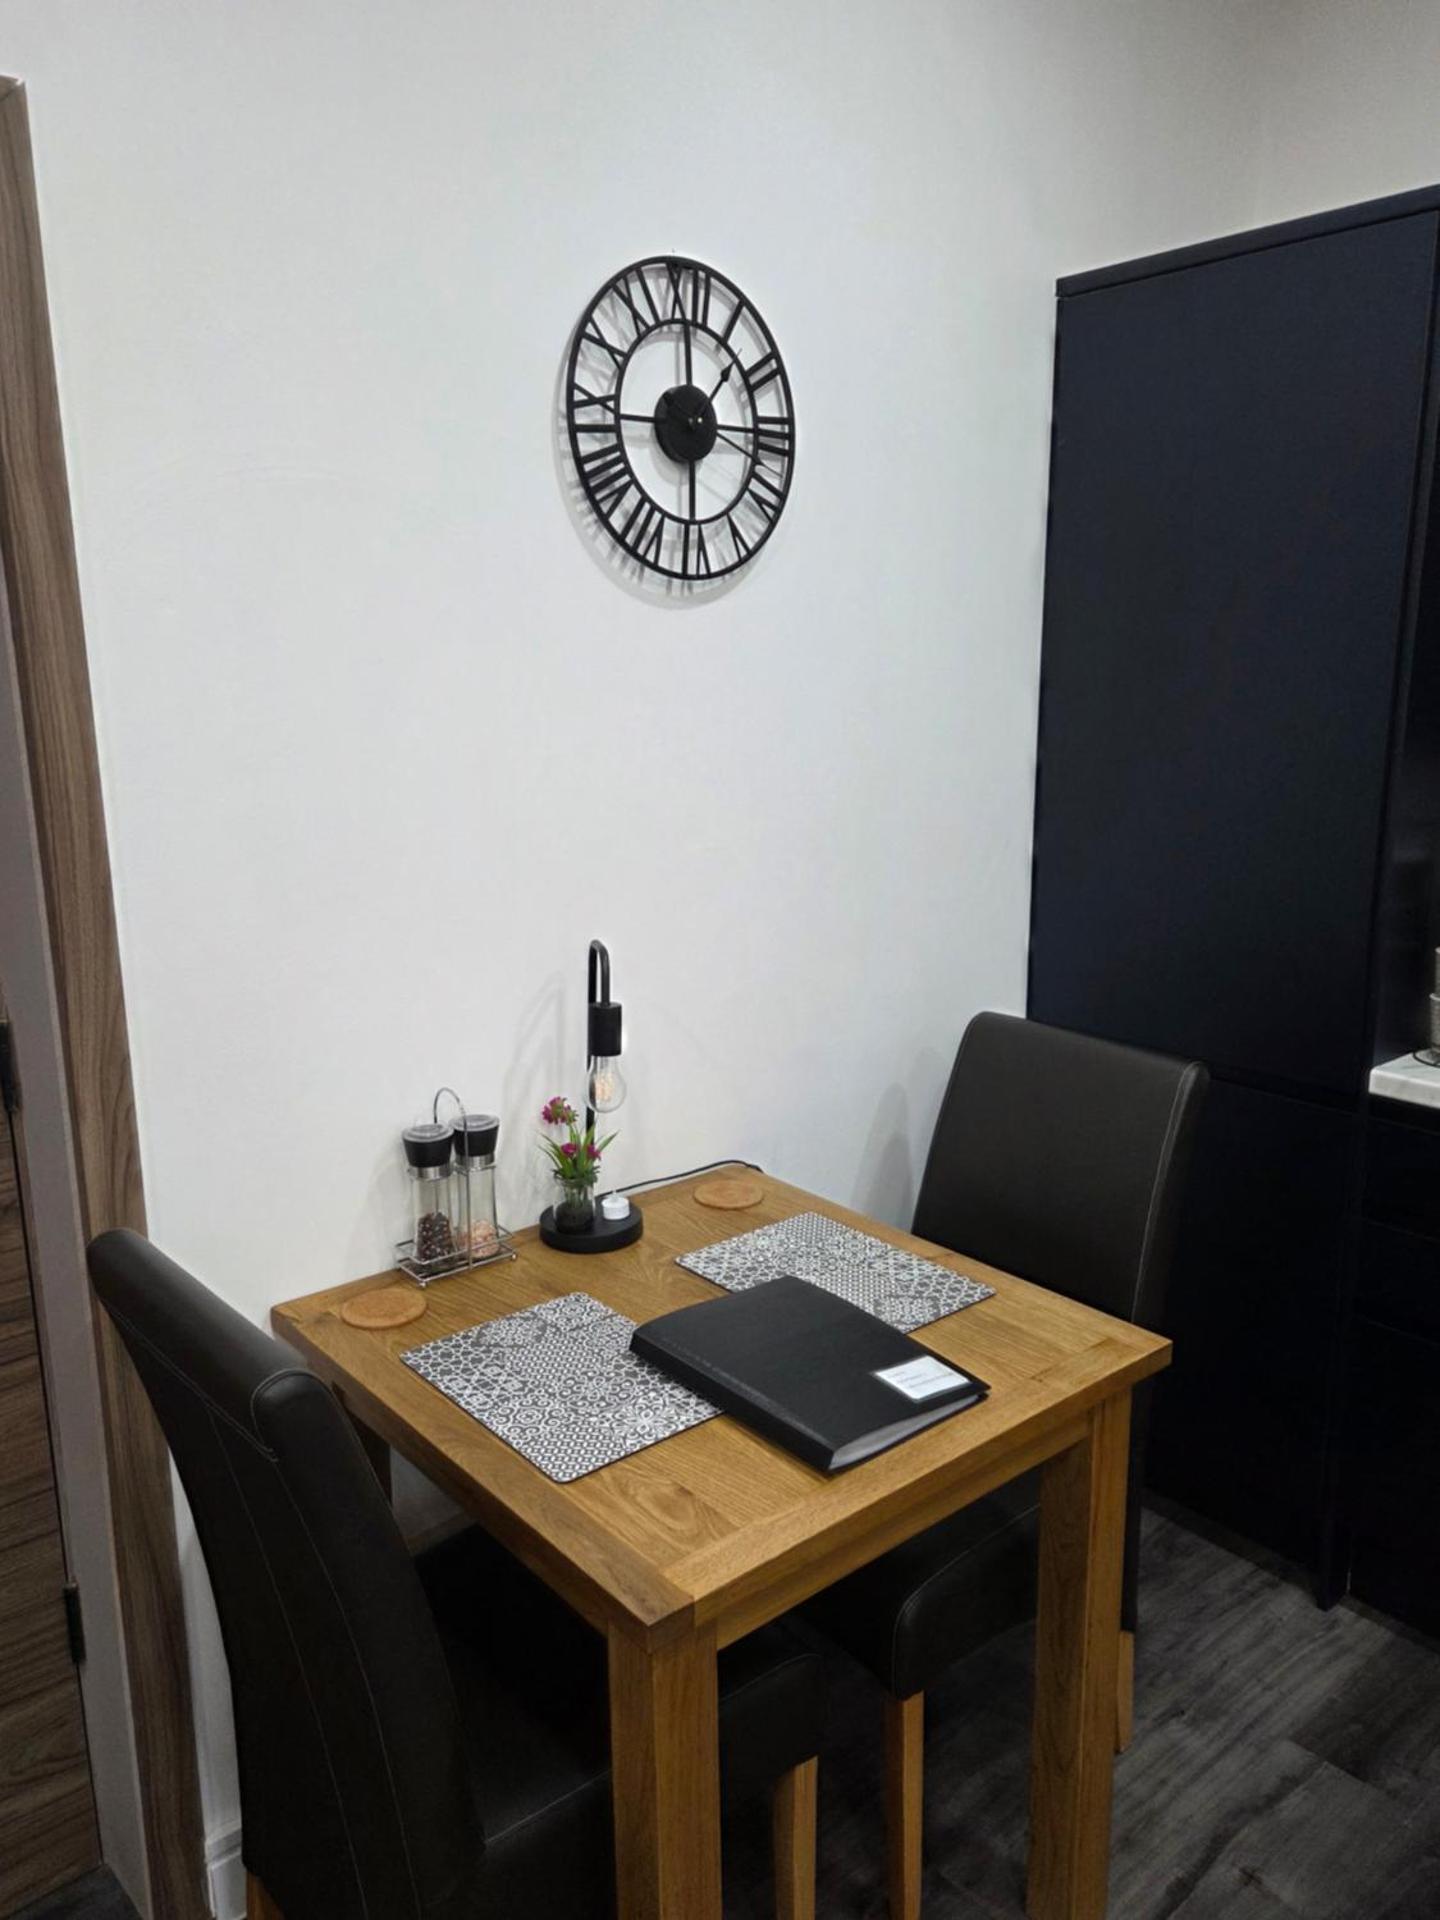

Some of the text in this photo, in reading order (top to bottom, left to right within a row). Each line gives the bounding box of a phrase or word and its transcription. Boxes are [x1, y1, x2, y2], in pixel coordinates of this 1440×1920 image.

[612, 267, 659, 335] XI
[666, 263, 711, 329] XII
[582, 316, 625, 368] X
[745, 352, 781, 392] II
[572, 383, 618, 433] IX
[757, 416, 791, 455] III
[682, 523, 711, 576] VI
[727, 512, 750, 560] V
